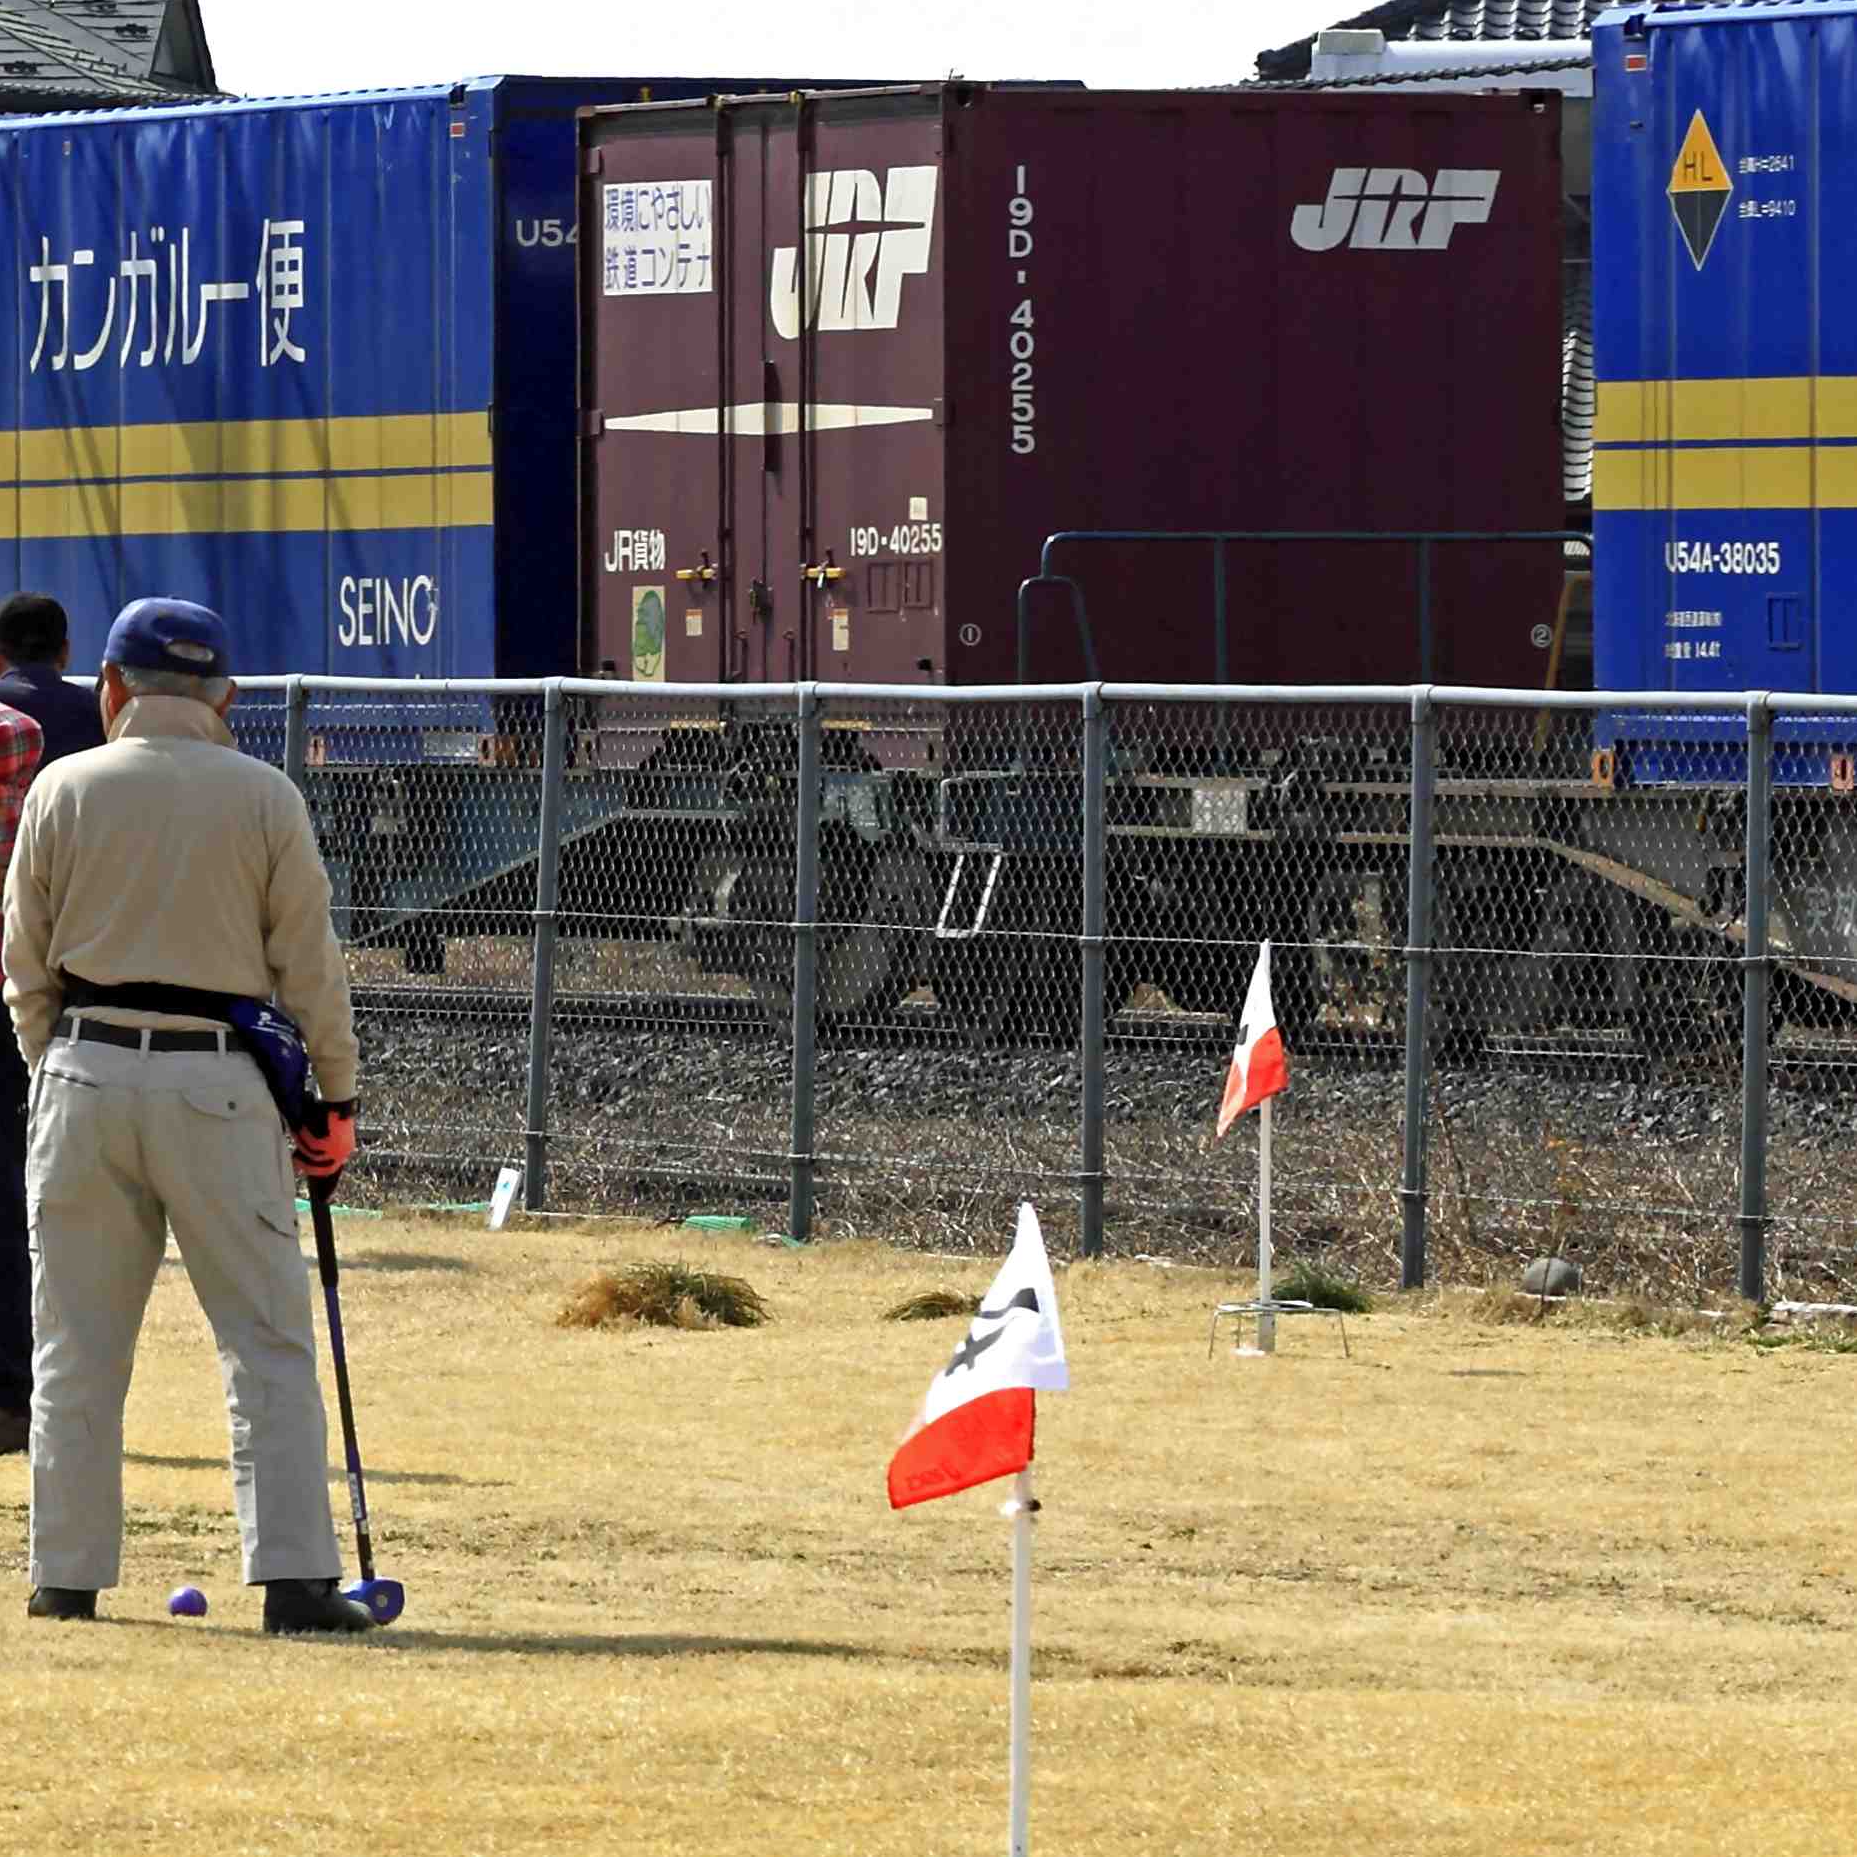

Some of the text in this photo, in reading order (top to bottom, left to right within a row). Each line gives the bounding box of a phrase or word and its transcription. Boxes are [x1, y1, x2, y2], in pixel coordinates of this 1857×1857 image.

[1684, 151, 1713, 182] HL
[1290, 167, 1501, 252] JRF
[606, 244, 711, 289] 鉄道コンテナ
[770, 166, 938, 340] JRF
[29, 218, 306, 374] カンガルー便
[1008, 165, 1037, 454] 19D-40255
[604, 529, 666, 572] JR貨物
[850, 523, 942, 557] 19D-40255
[1665, 541, 1781, 574] U54A-38035
[338, 575, 438, 647] SEINO
